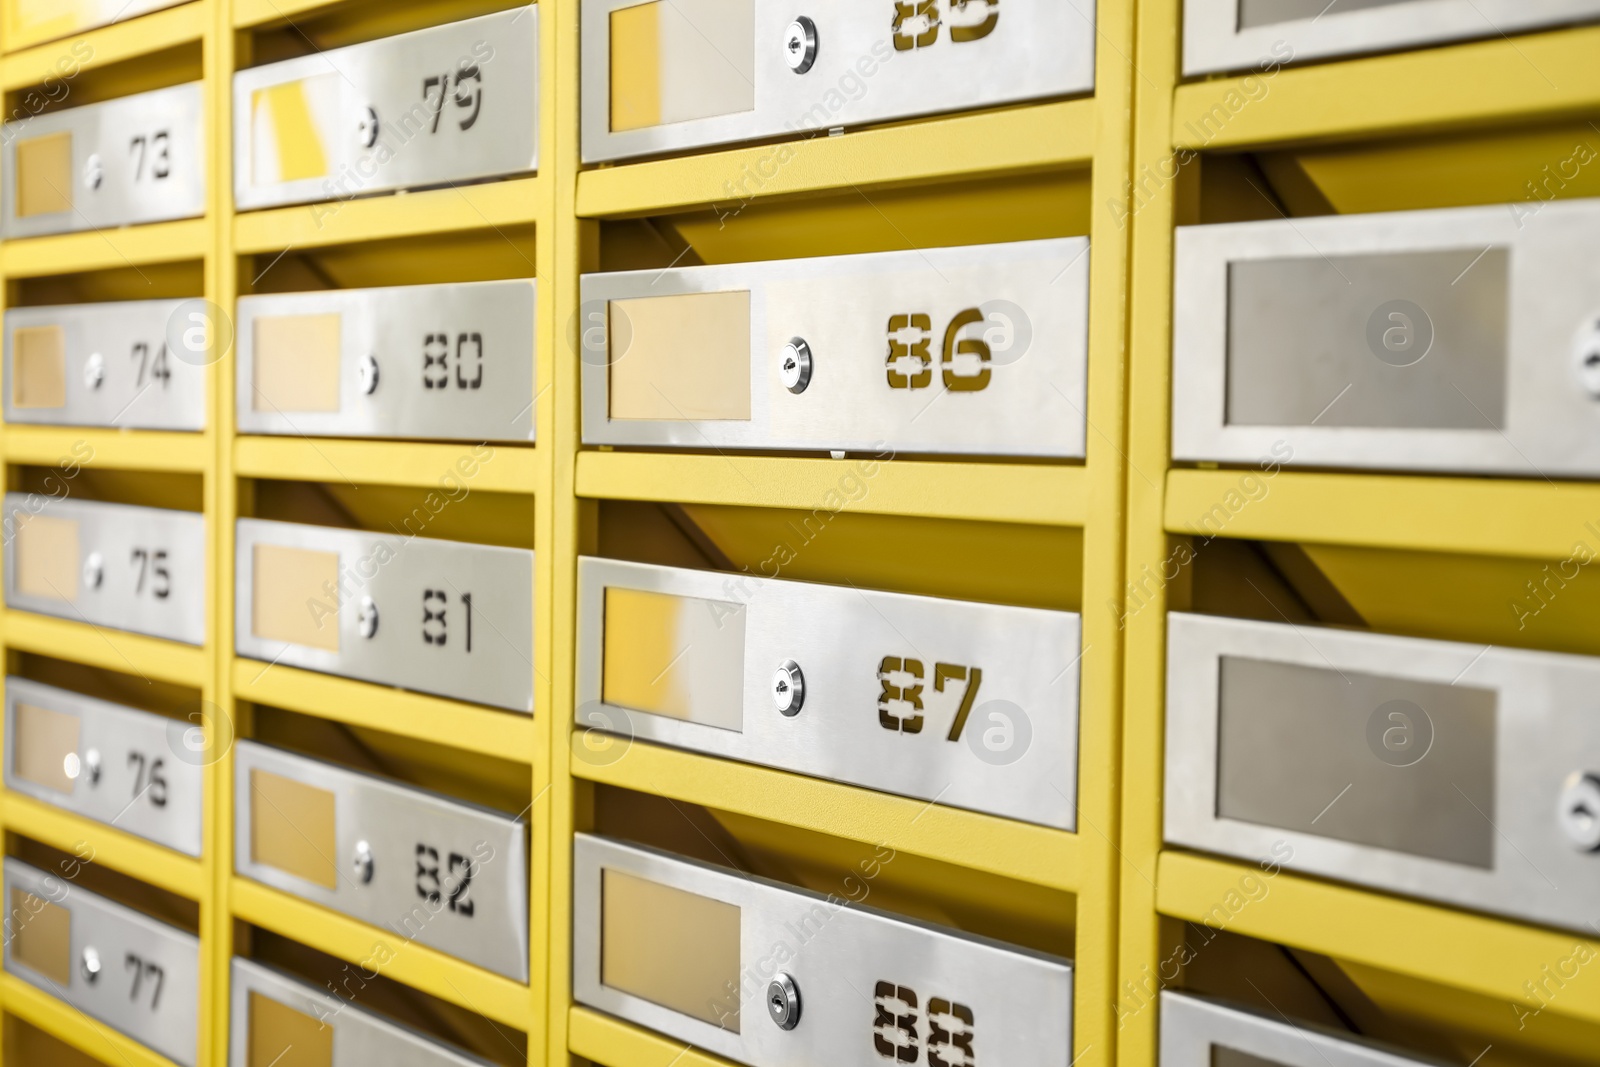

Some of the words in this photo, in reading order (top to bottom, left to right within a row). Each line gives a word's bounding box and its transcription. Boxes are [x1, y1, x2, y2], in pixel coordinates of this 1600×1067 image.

[423, 66, 481, 133] 79
[131, 131, 169, 179] 73
[132, 342, 171, 386] 74
[424, 333, 482, 389] 80
[886, 308, 991, 392] 86
[132, 549, 170, 600] 75
[423, 590, 471, 652] 81
[877, 656, 982, 742] 87
[129, 752, 167, 808] 76
[416, 844, 474, 917] 82
[125, 953, 164, 1008] 77
[873, 981, 974, 1067] 88
